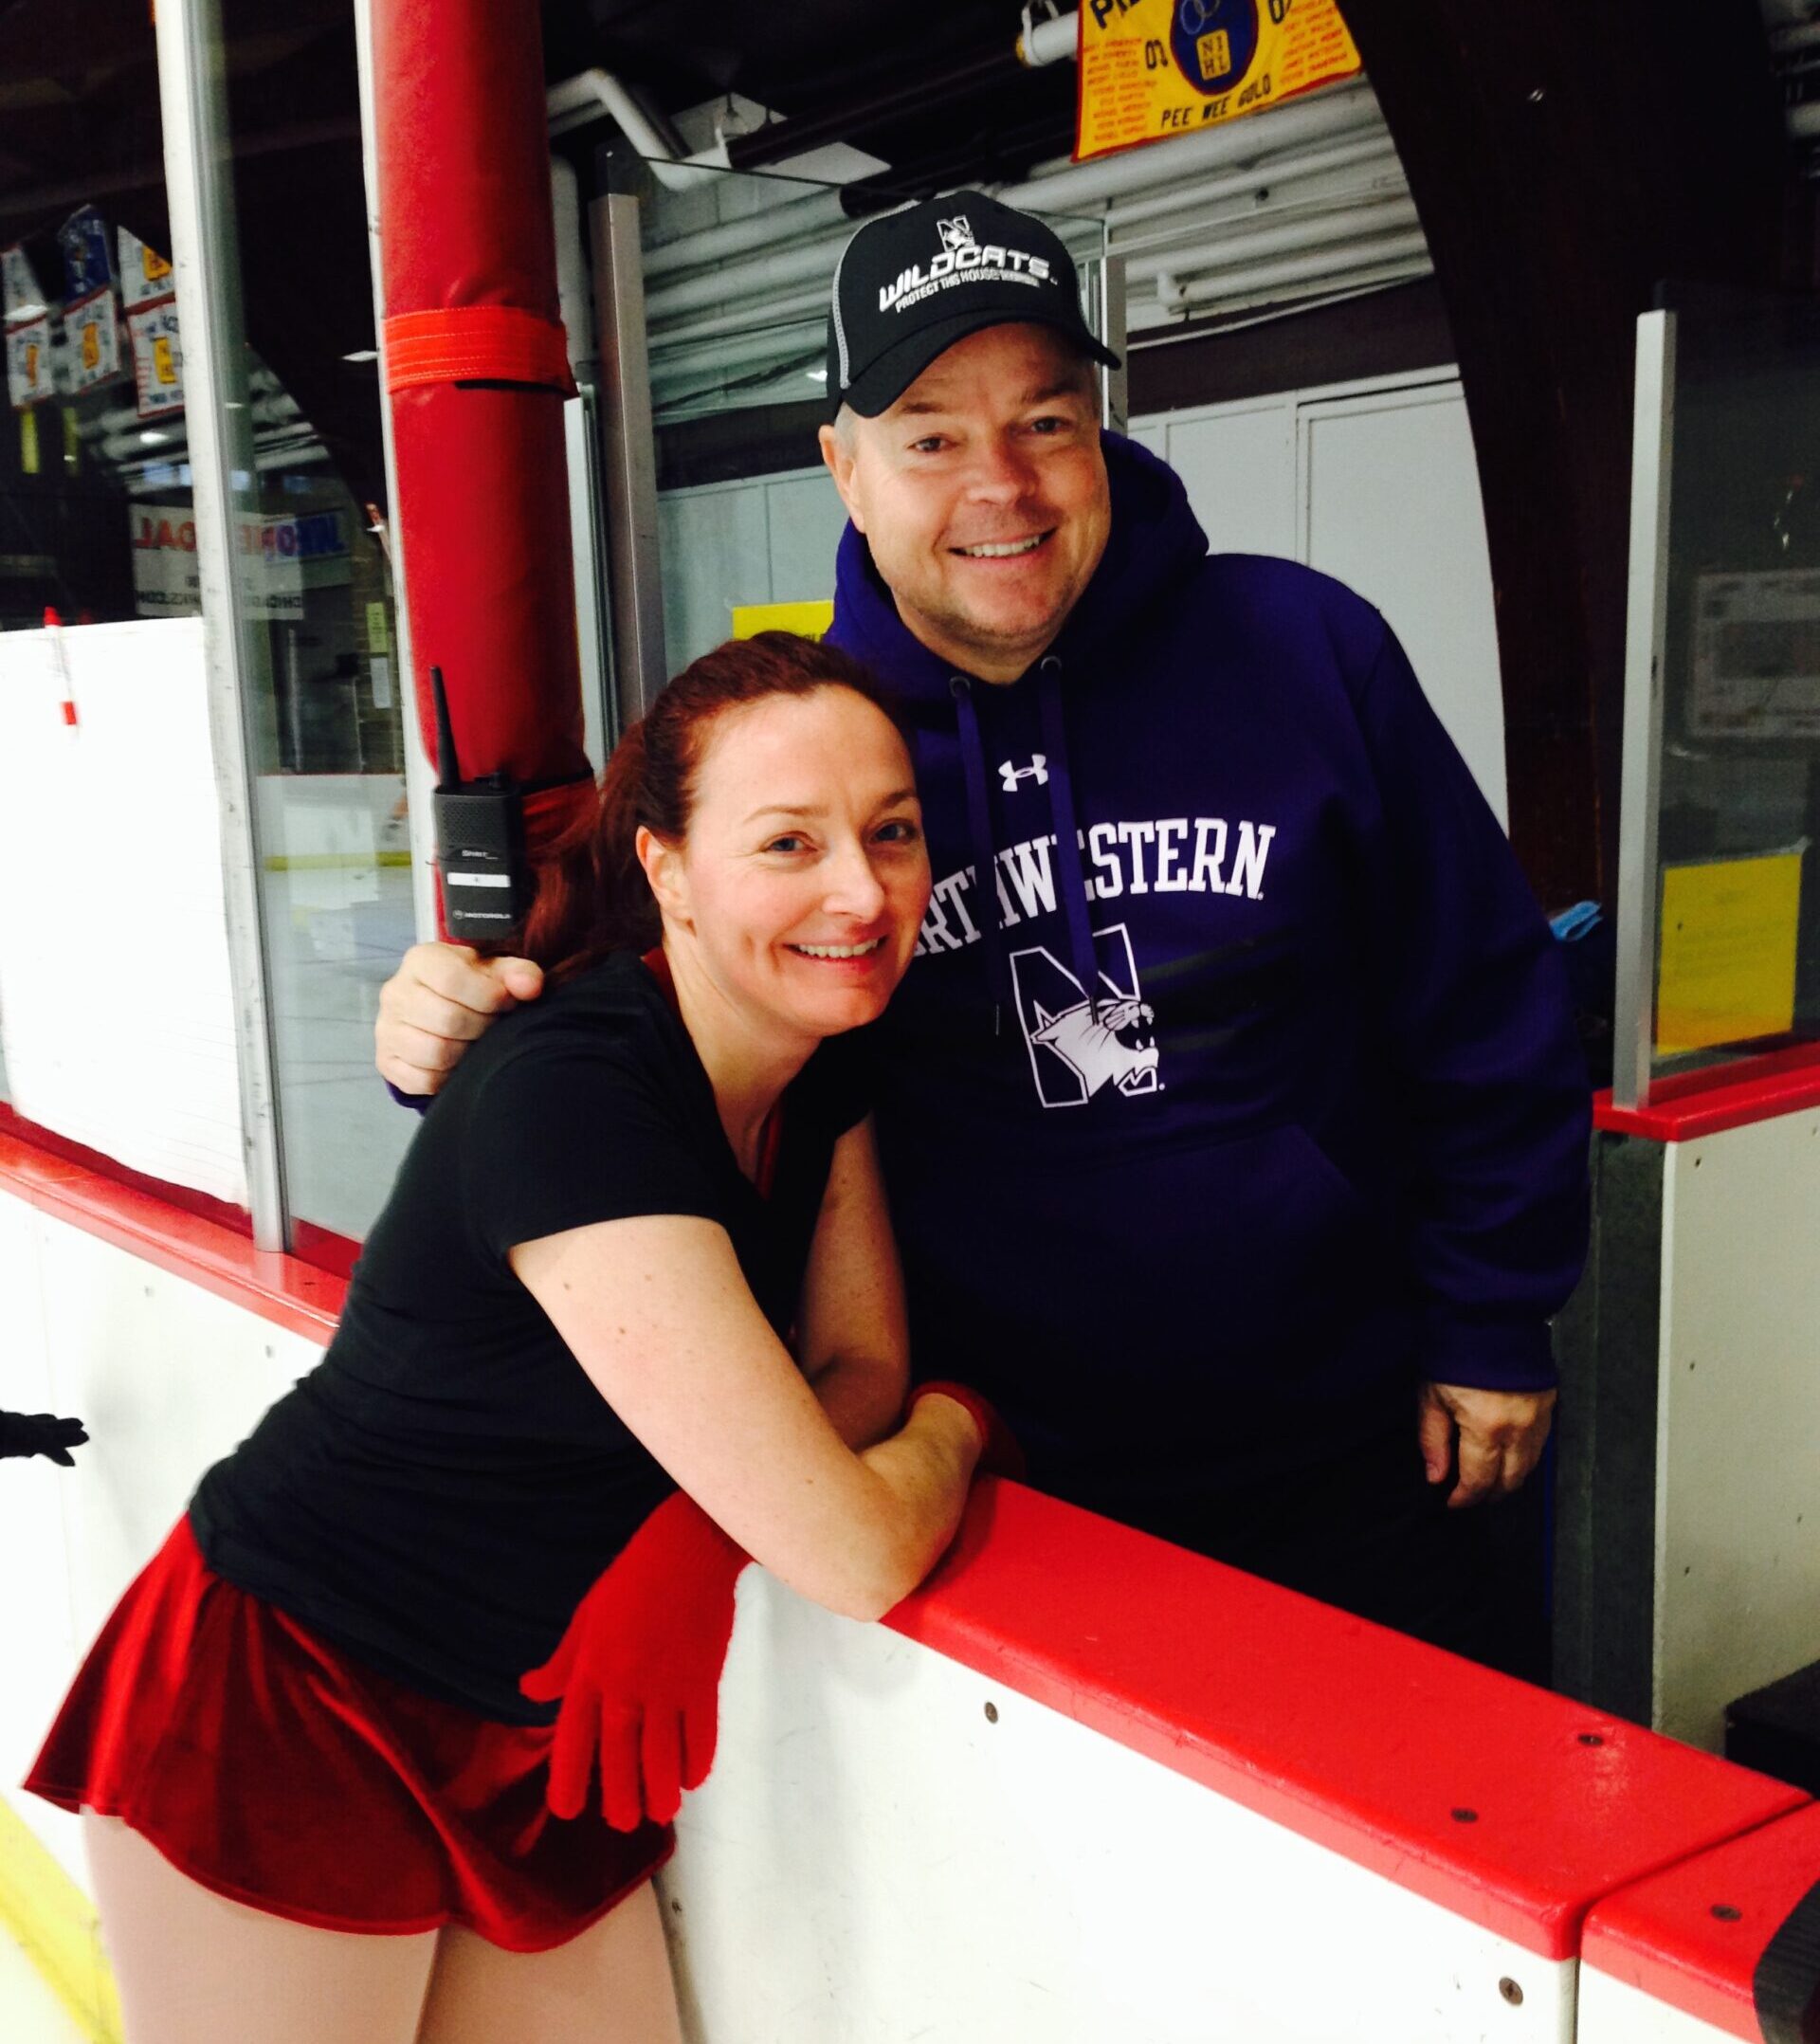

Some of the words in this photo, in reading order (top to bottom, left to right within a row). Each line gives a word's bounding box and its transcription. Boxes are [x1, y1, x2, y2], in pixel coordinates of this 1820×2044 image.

[1161, 107, 1192, 128] PEE
[1202, 97, 1229, 119] WEE
[1237, 73, 1271, 108] GOLD
[879, 245, 1050, 313] WILDCATS
[895, 281, 939, 313] PROTECT
[939, 272, 961, 290] THIS
[960, 267, 1000, 283] HOUSE
[914, 817, 1277, 958] RTWSTERN
